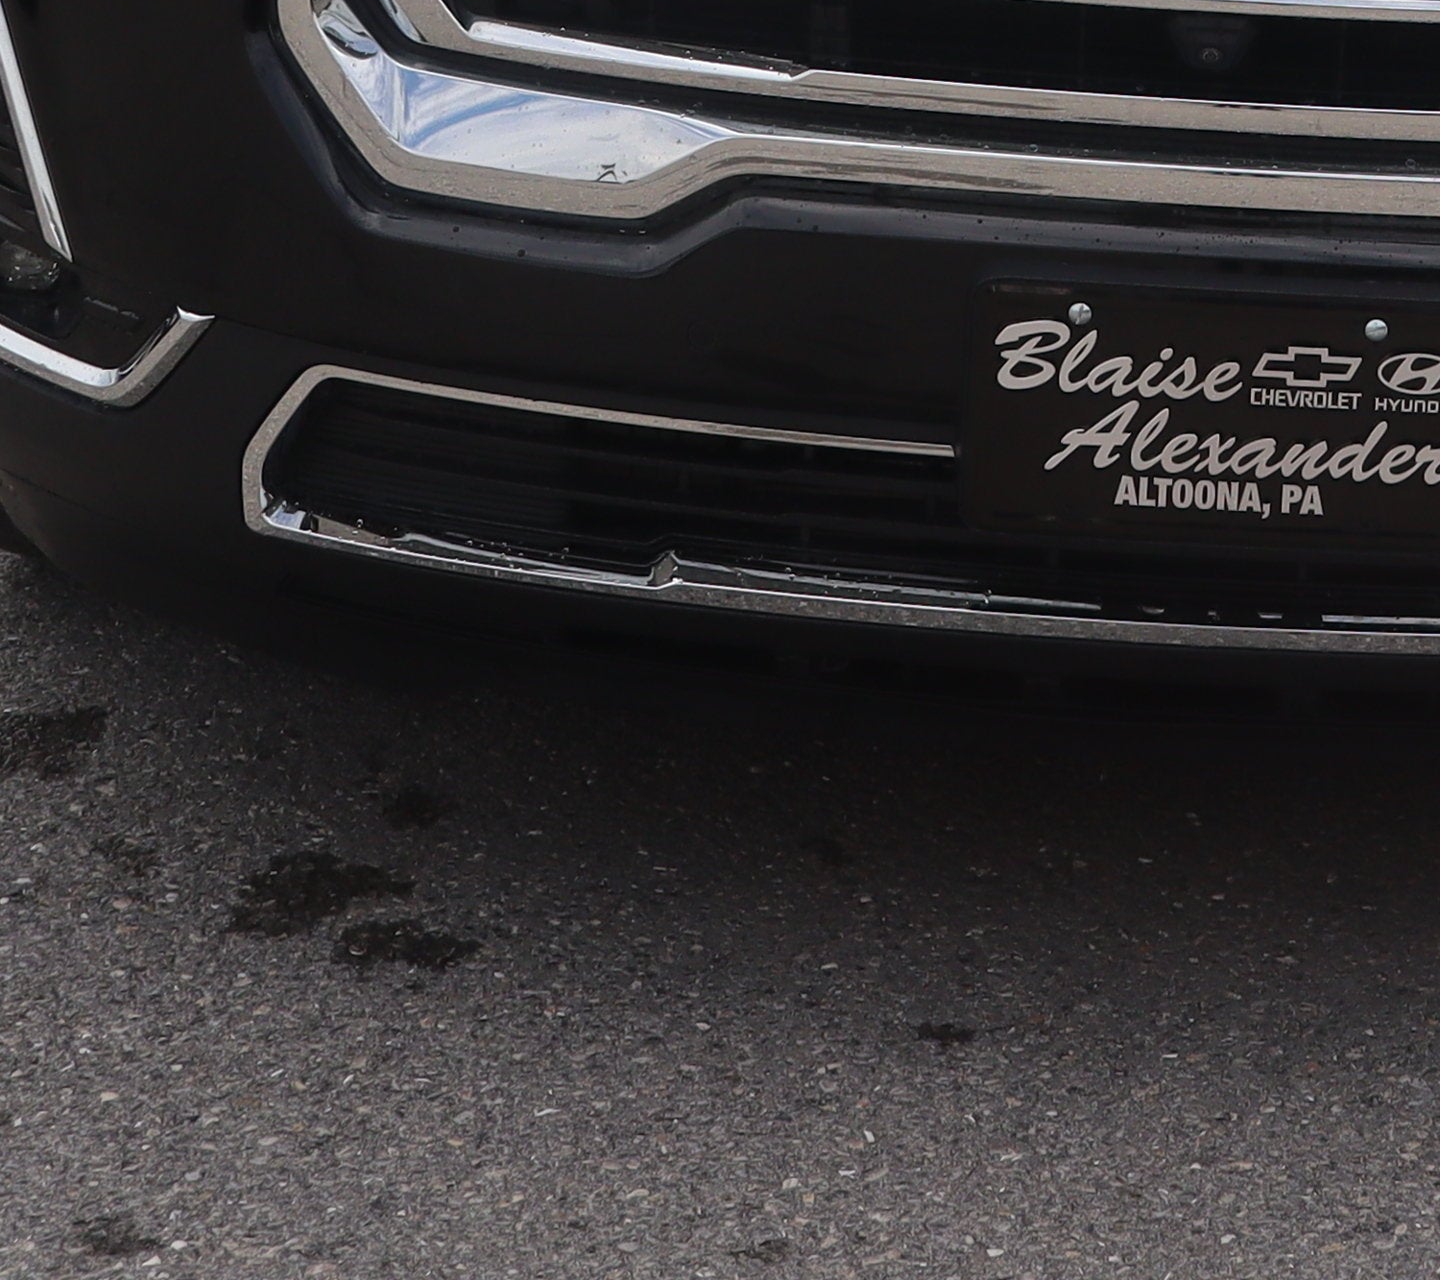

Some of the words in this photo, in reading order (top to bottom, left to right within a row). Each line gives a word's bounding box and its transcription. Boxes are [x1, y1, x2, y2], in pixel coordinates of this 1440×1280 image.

[994, 318, 1244, 404] Blaise
[1250, 386, 1363, 411] CHEVROLET
[1113, 474, 1272, 520] ALTOONA,
[1281, 483, 1325, 517] PA
